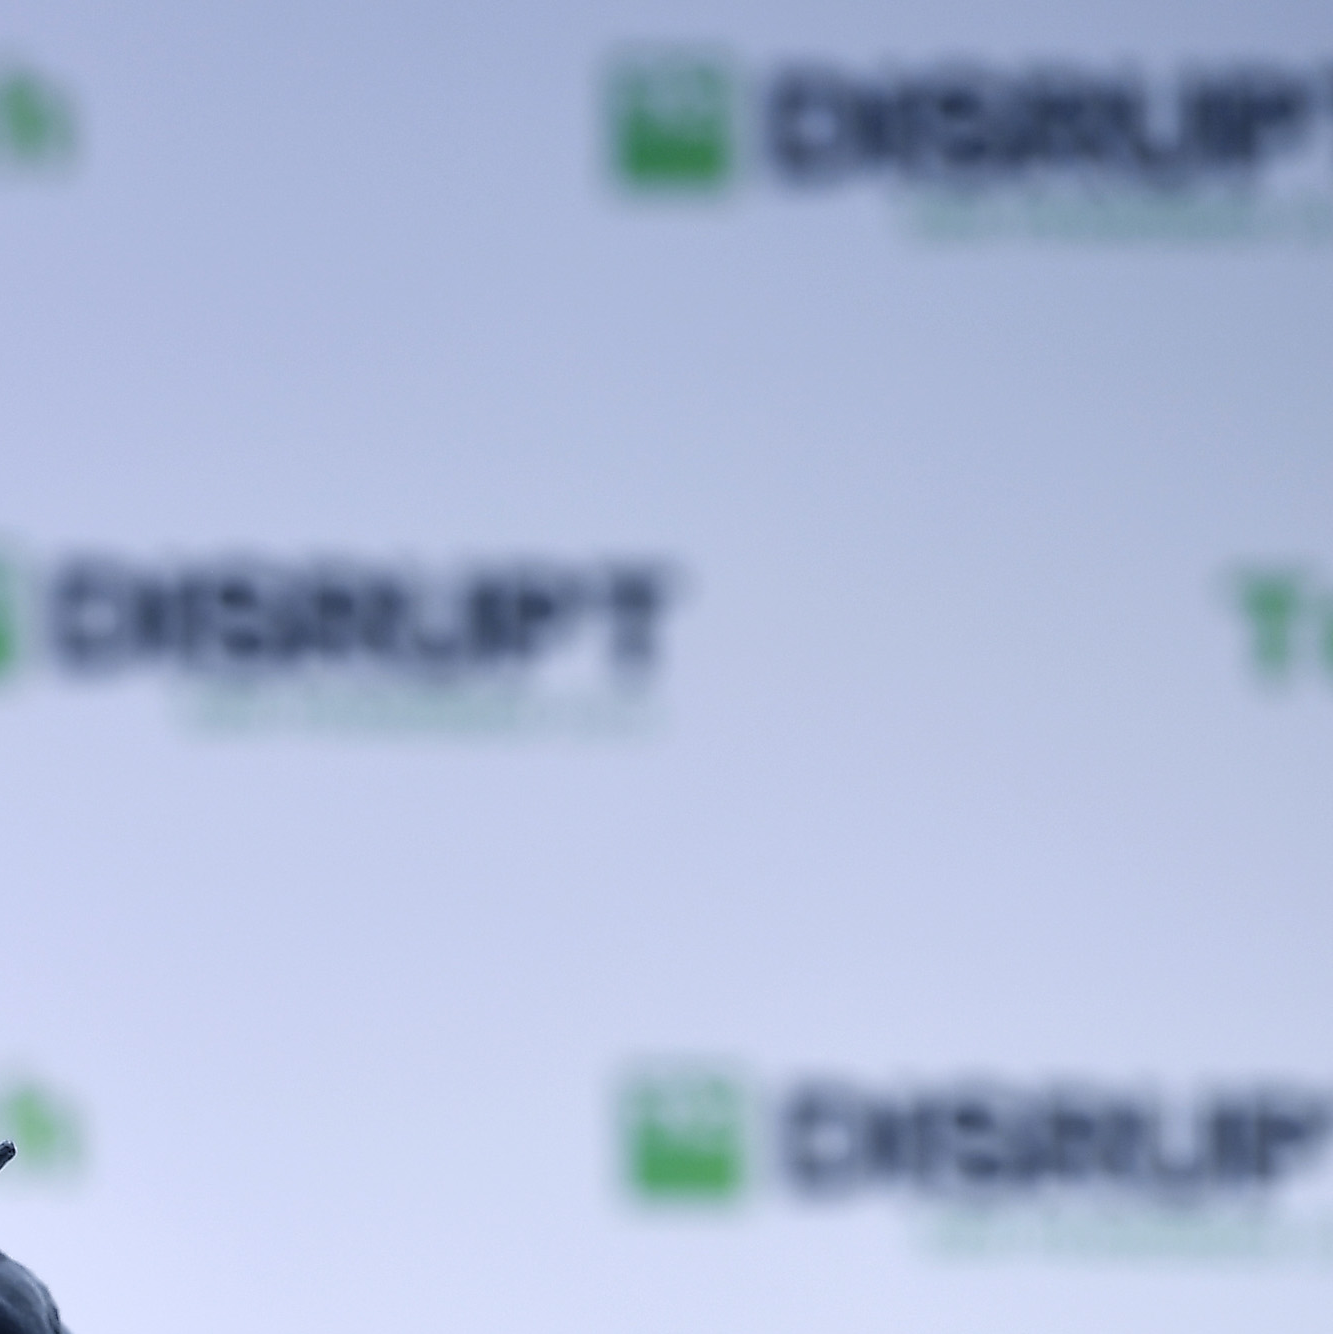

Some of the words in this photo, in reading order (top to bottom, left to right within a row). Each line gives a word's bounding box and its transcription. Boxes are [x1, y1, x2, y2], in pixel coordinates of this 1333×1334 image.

[766, 58, 1333, 188] DISRUP
[53, 560, 675, 682] DISRUPT
[780, 1072, 1333, 1203] DISRUP
